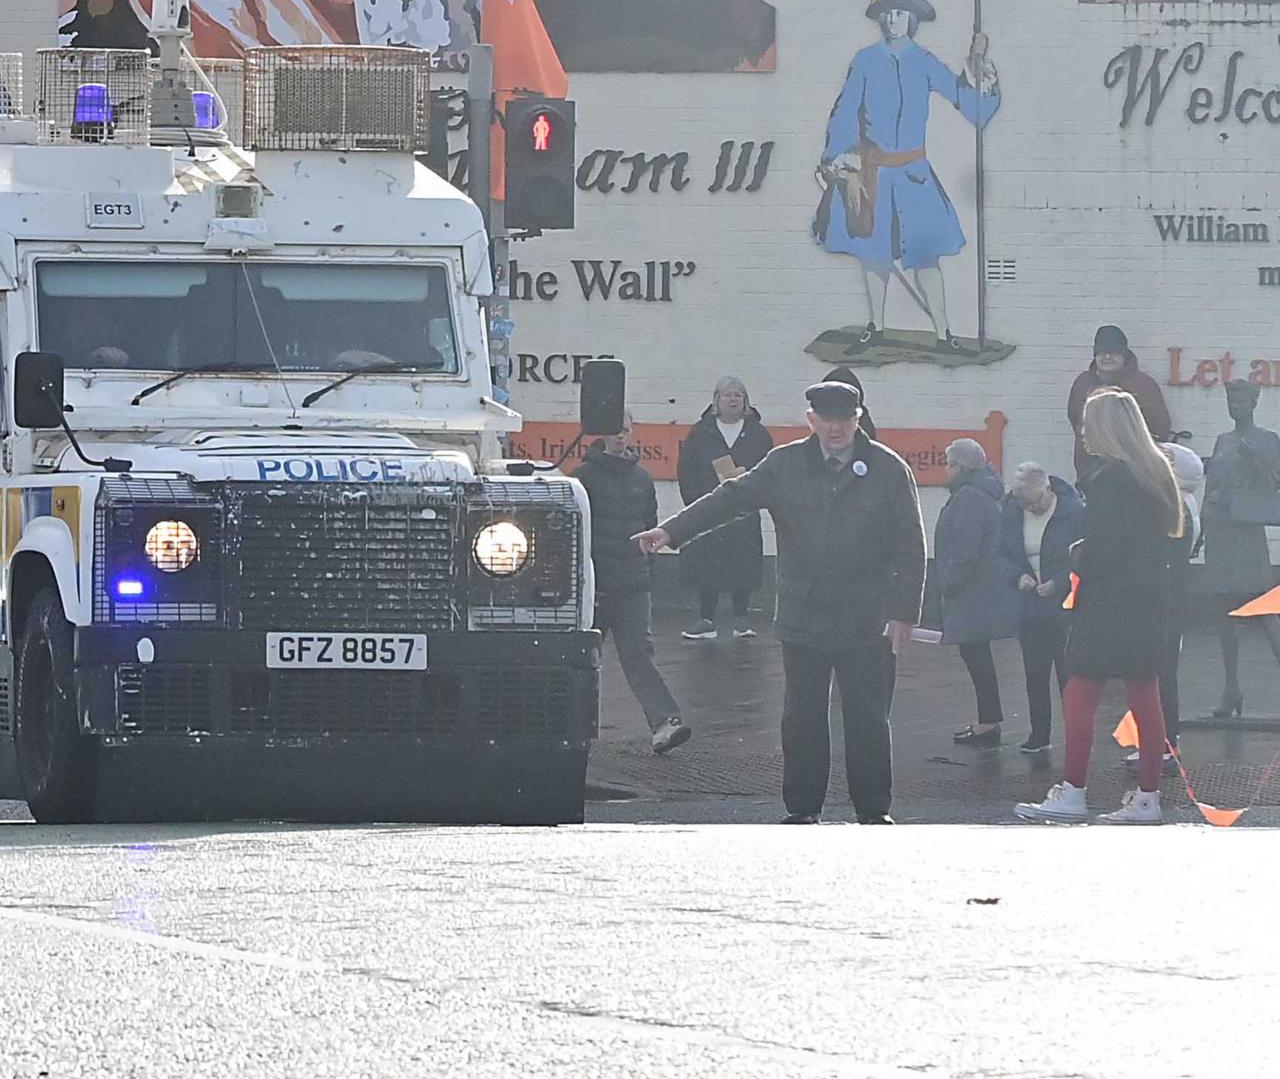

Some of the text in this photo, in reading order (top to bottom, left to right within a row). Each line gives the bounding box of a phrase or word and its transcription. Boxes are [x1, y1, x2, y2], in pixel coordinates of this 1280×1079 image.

[93, 203, 133, 216] EGT3
[1152, 214, 1270, 243] William
[509, 259, 559, 301] he
[1166, 346, 1236, 388] Let
[256, 459, 406, 481] POLICE
[278, 637, 415, 664] GFZ 8857
